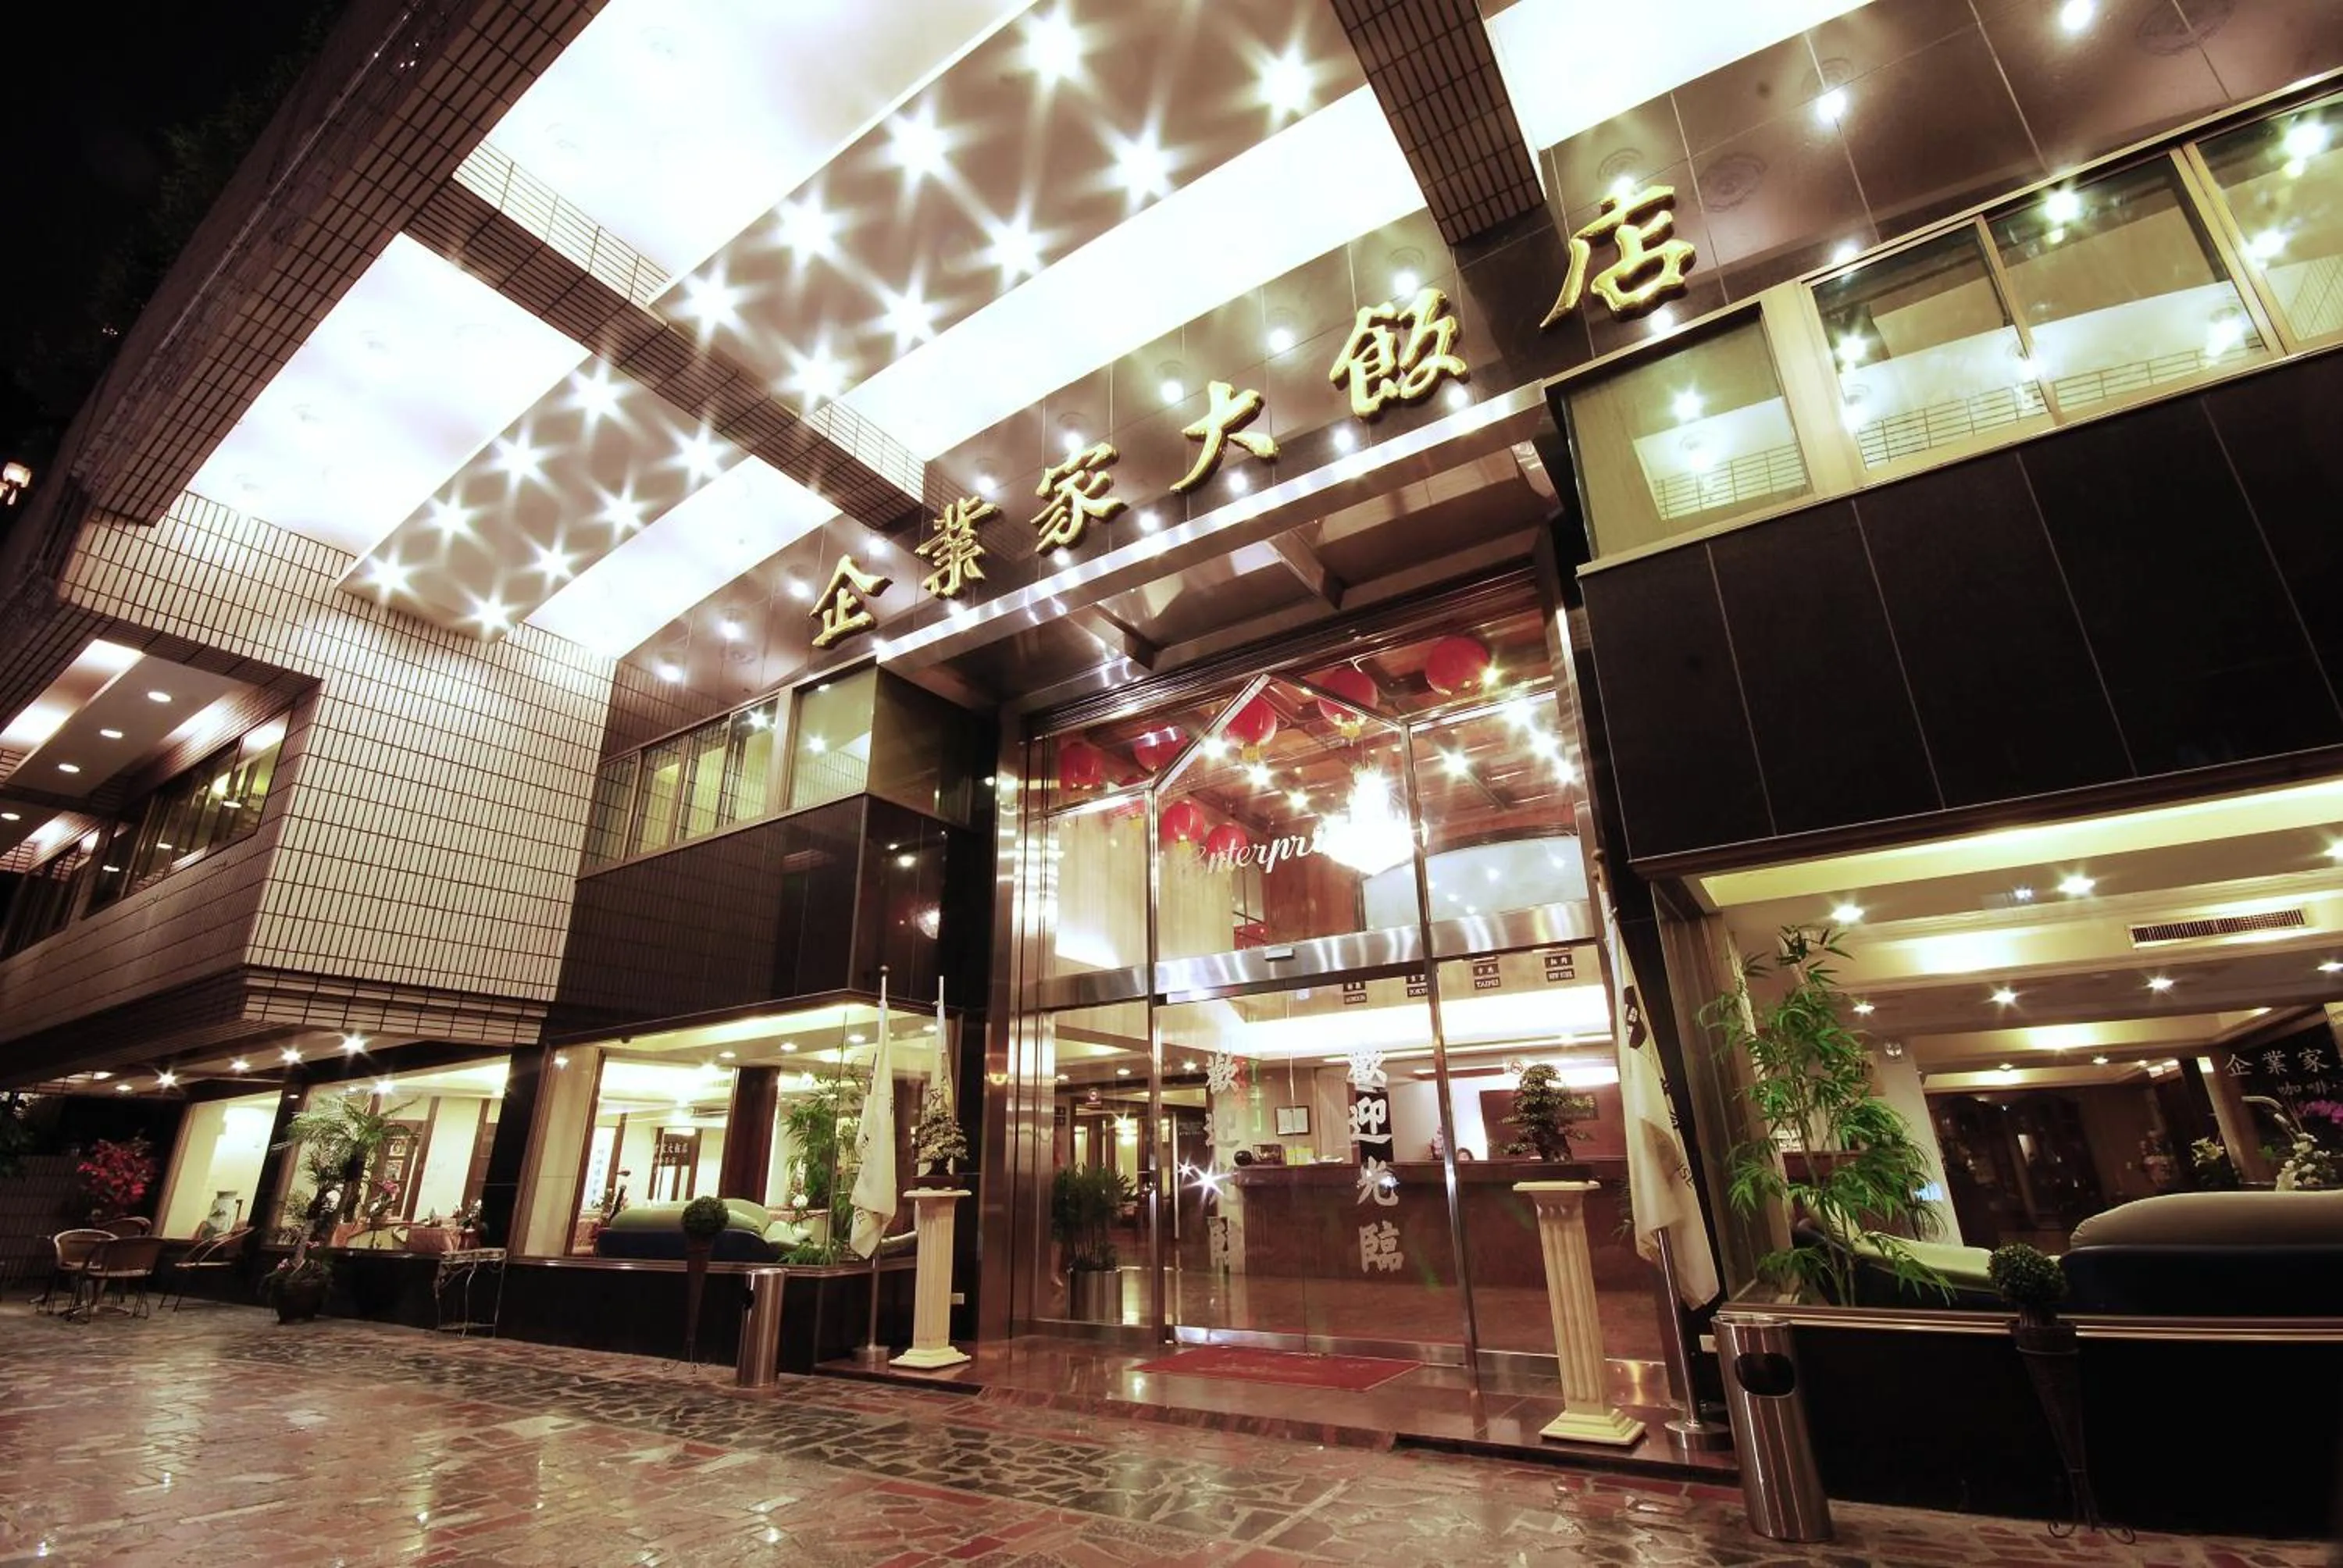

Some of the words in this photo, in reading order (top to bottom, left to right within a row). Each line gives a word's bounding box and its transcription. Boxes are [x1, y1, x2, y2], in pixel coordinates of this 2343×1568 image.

[808, 184, 1695, 647] 企業家大飯店
[1347, 1049, 1404, 1273] 歡迎光臨
[2226, 1049, 2343, 1077] 企業家
